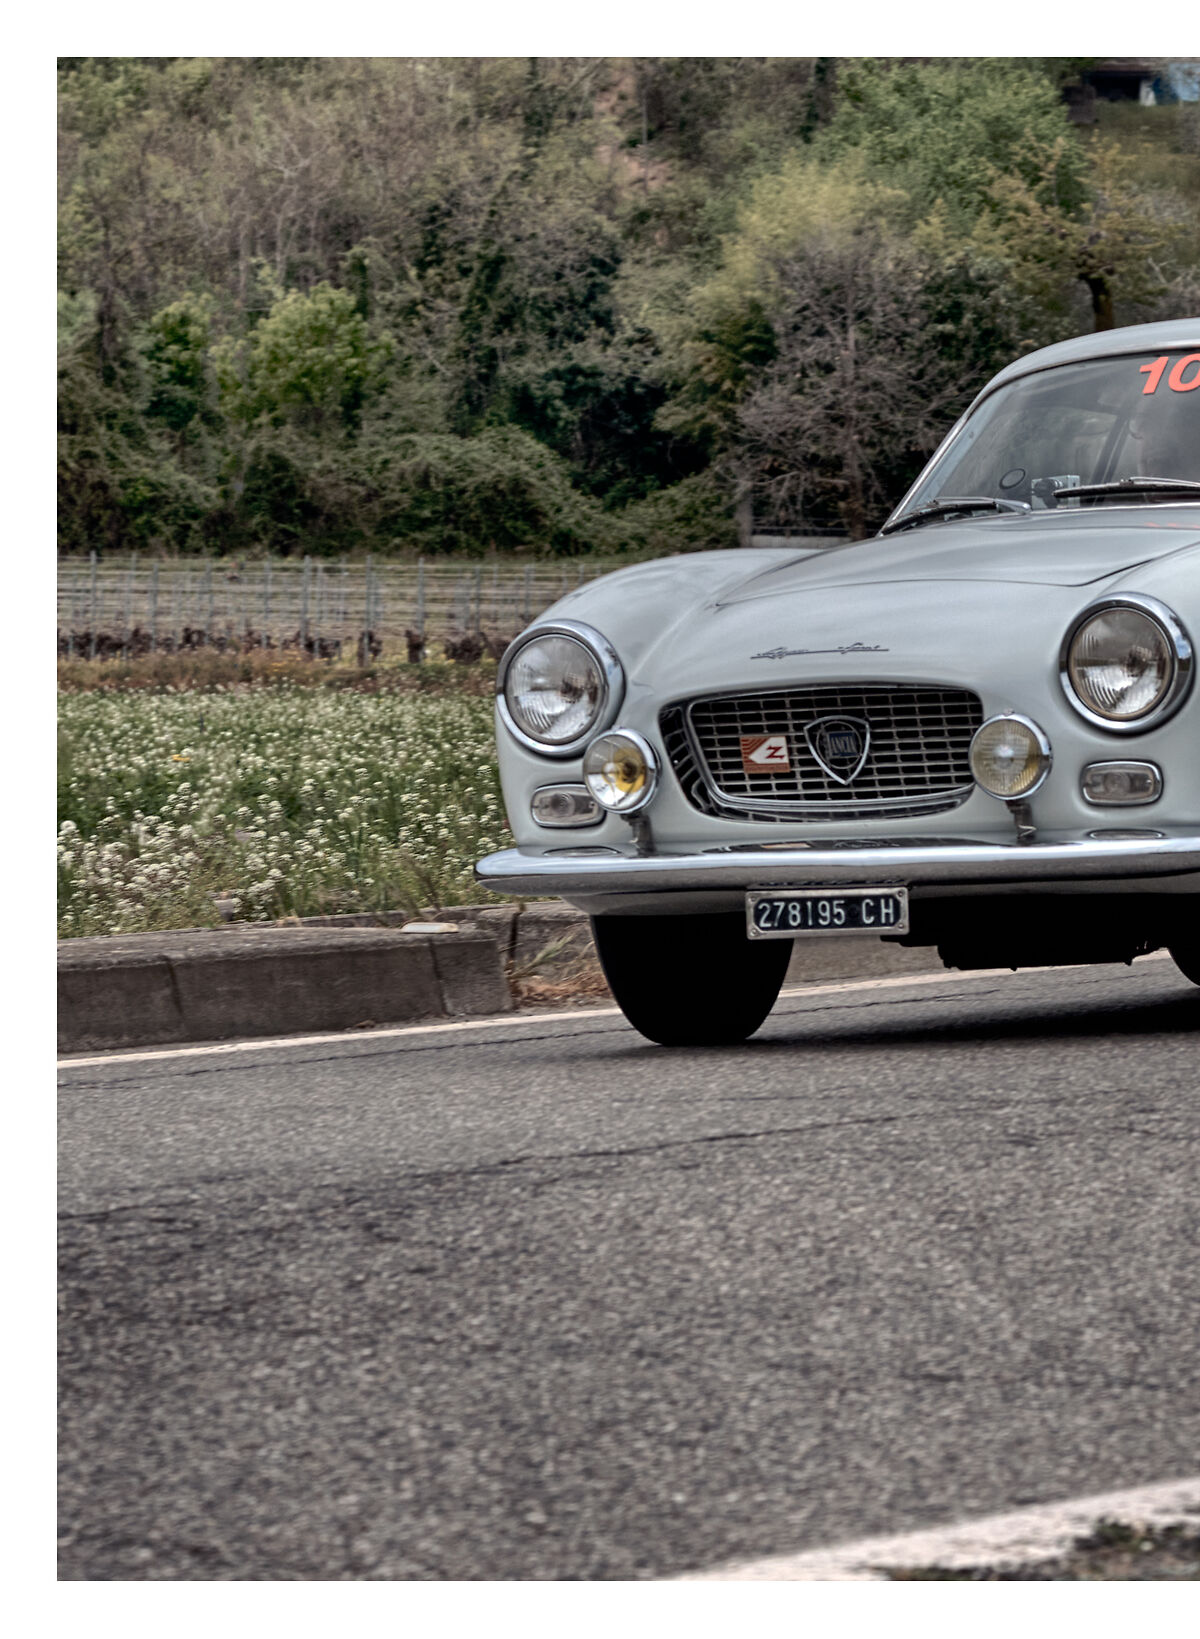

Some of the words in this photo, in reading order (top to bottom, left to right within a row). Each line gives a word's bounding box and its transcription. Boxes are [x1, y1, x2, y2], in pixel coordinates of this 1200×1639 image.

[765, 744, 786, 760] Z
[757, 898, 846, 929] 278195
[862, 897, 896, 926] CH
